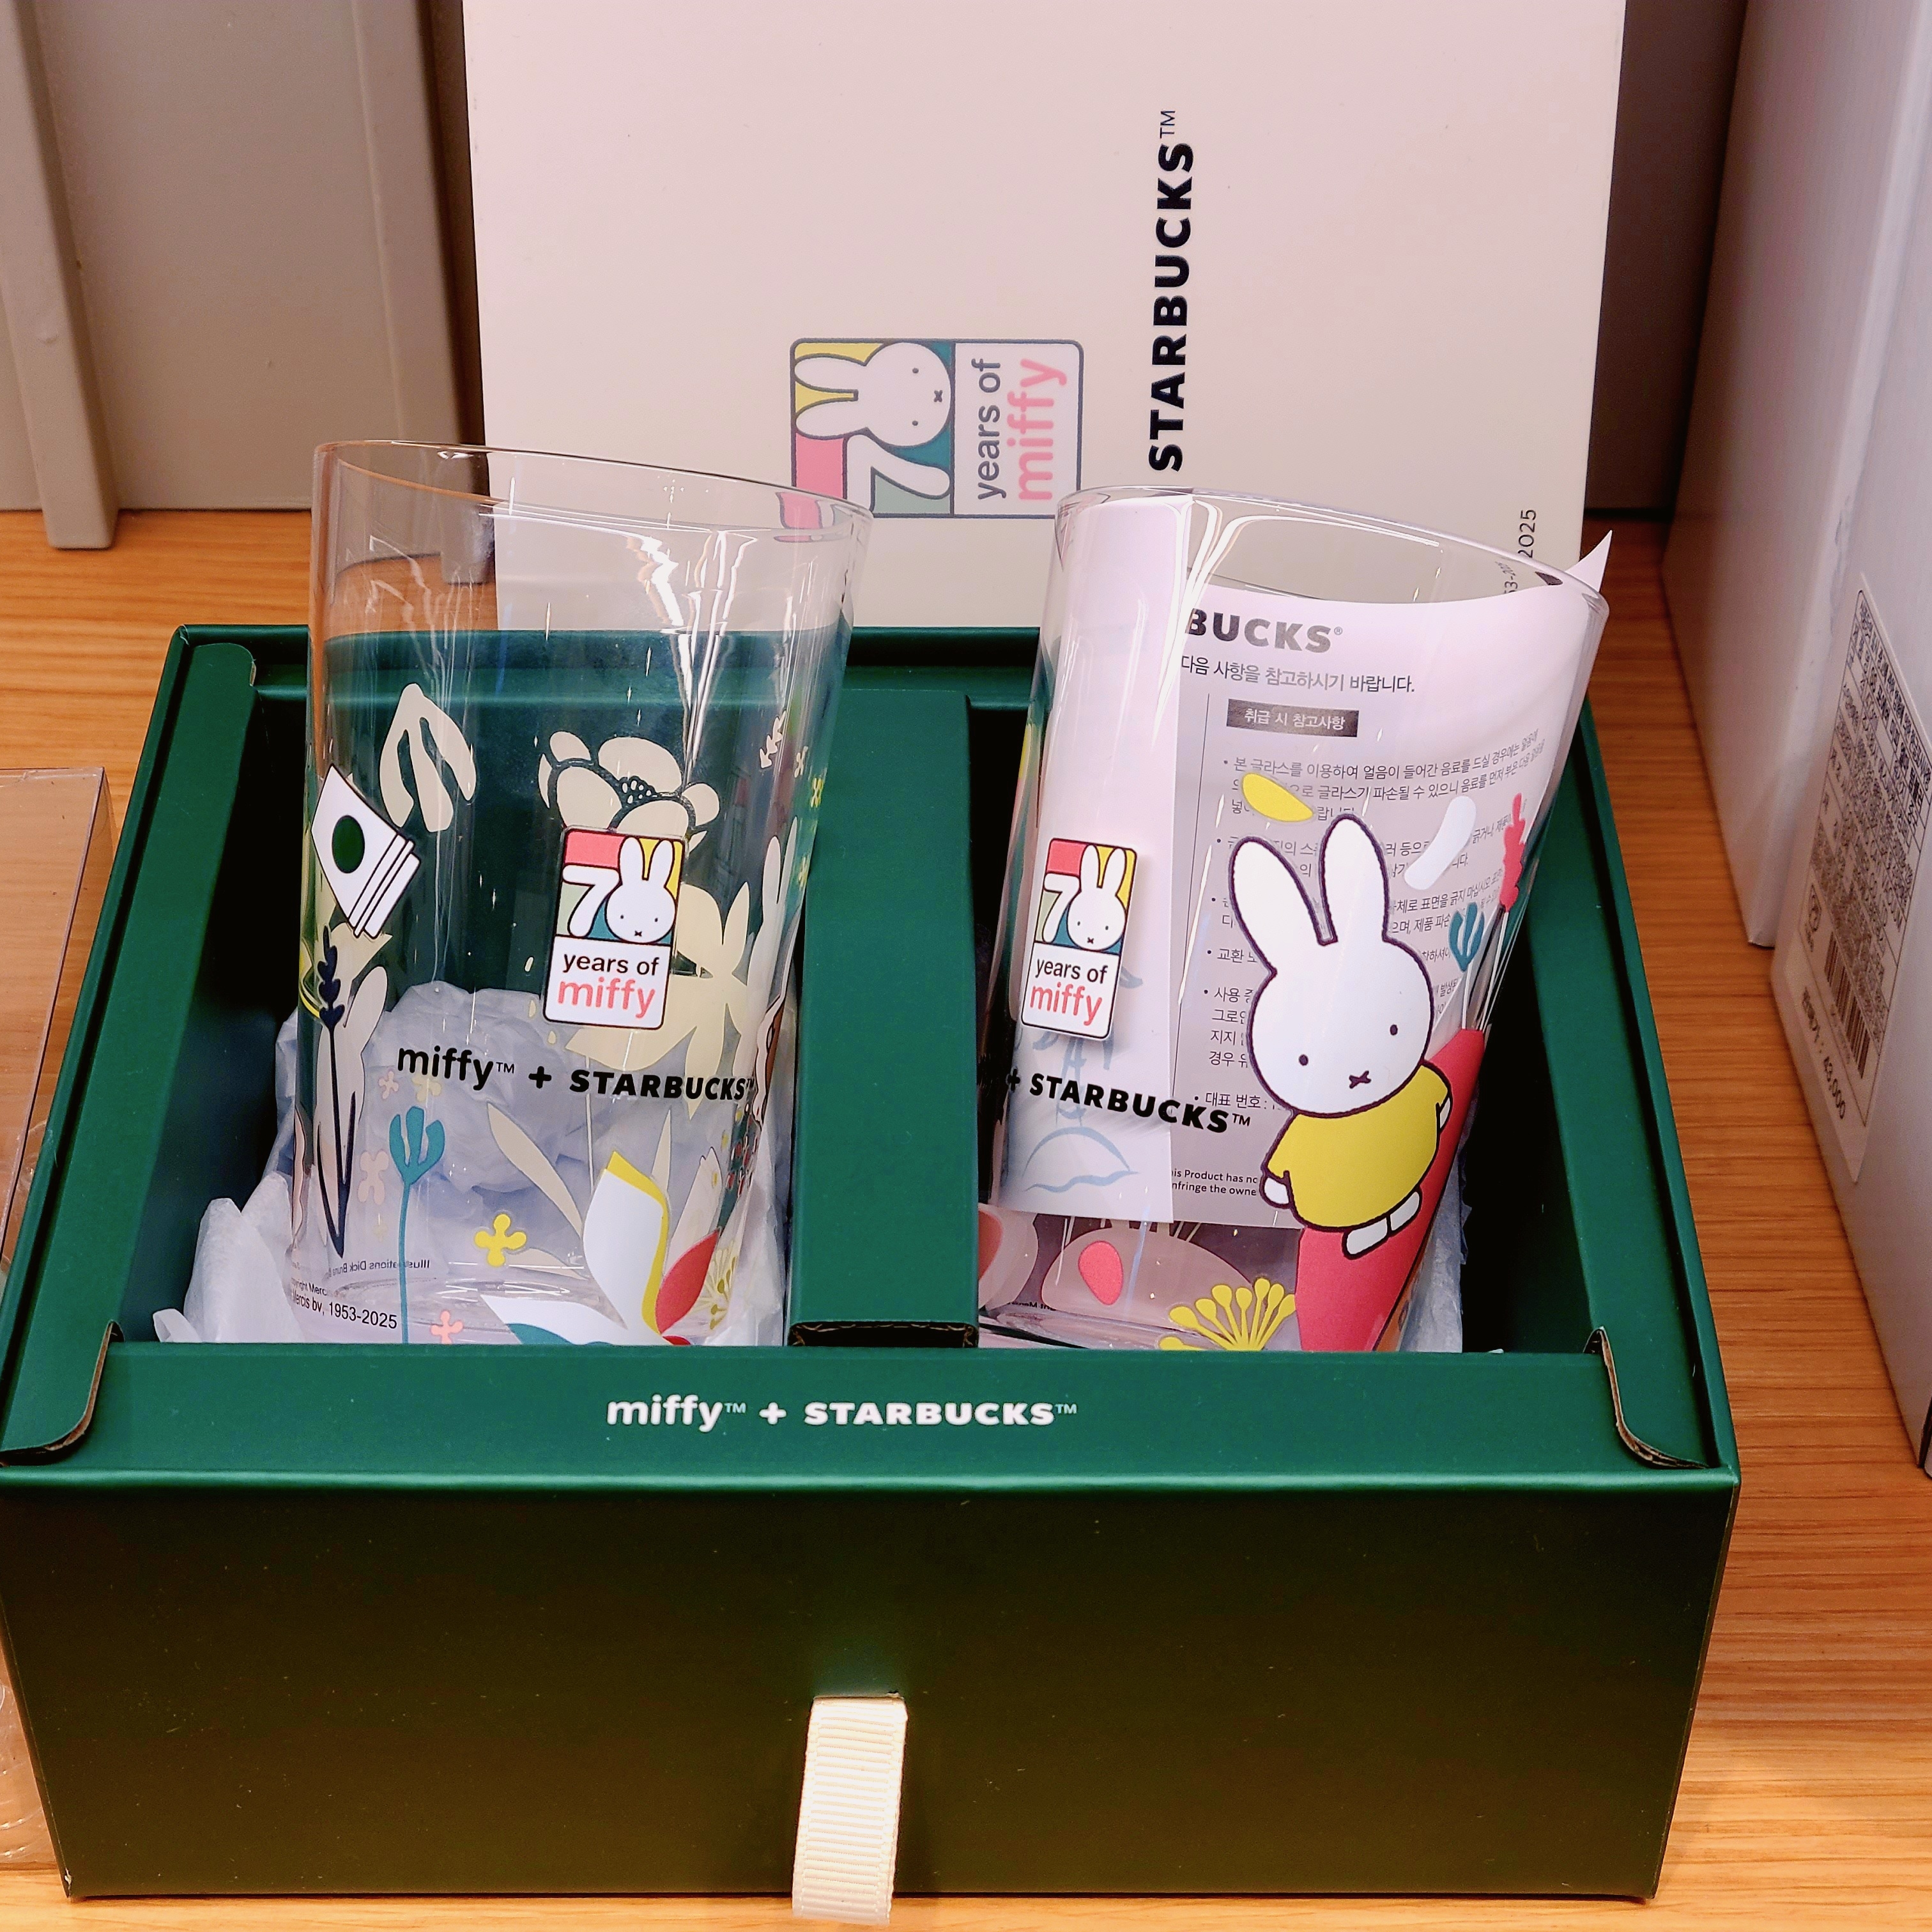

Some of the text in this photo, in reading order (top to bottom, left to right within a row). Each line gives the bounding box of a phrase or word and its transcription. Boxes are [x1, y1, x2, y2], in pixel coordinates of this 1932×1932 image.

[971, 358, 1007, 500] years of
[1006, 358, 1068, 502] miffy
[1213, 660, 1261, 684] 사항을
[1265, 666, 1345, 691] 참고하시기
[1349, 674, 1416, 693] 바랍니다.
[1244, 707, 1346, 731] 취급 시 참고사항
[1234, 756, 1247, 773] 본
[1250, 758, 1303, 778] 글라스를
[1307, 763, 1359, 780] 이용하여
[1363, 765, 1400, 781] 얼음이
[1403, 763, 1438, 779] 들어간
[1440, 758, 1471, 777] 음료를
[1472, 753, 1491, 770] 드실
[1373, 785, 1410, 801] 파손될
[1413, 785, 1425, 800] 수
[1427, 779, 1459, 799] 있으니
[1460, 774, 1487, 793] 음료를
[1489, 767, 1505, 785] 먼저
[1420, 893, 1449, 911] 표면을
[1413, 917, 1434, 933] 제품
[562, 953, 660, 976] years of
[1216, 948, 1245, 963] 교환
[1034, 957, 1108, 985] years of
[556, 976, 656, 1019] miffy
[1029, 981, 1103, 1027] miffy
[1214, 986, 1241, 1004] 사용
[1209, 1029, 1237, 1046] 지지
[1208, 1051, 1236, 1068] 경우
[1204, 1091, 1232, 1107] 대표
[1236, 1094, 1261, 1110] 번호
[1184, 1169, 1224, 1182] Product
[1226, 1172, 1244, 1183] has
[1209, 1184, 1227, 1194] the
[328, 1301, 398, 1330] 1953-2025
[803, 1402, 1078, 1427] STARBUCKS™
